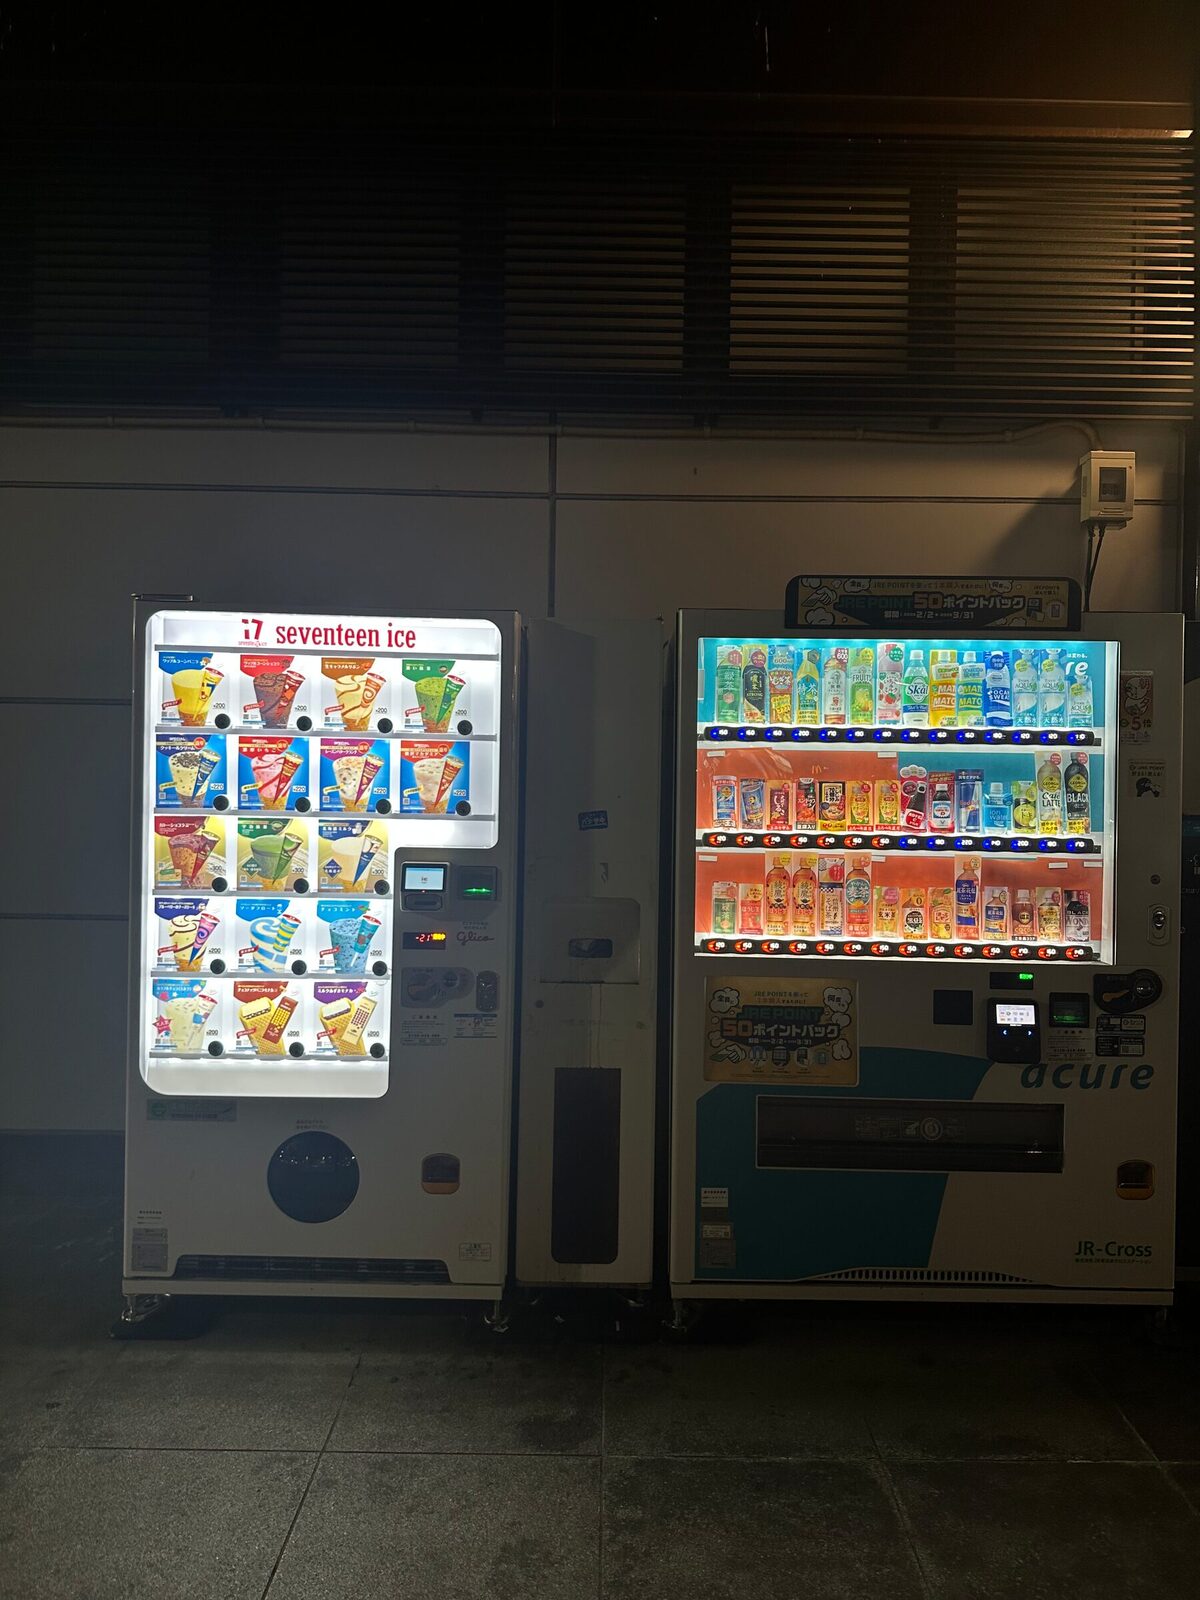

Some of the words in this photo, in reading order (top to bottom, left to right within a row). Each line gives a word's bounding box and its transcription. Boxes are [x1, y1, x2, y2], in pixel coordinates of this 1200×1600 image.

[276, 624, 381, 648] seventeen
[387, 622, 417, 649] ice
[456, 931, 496, 946] Glico
[1021, 1062, 1155, 1090] acure
[1075, 1241, 1153, 1257] JR-Cross
